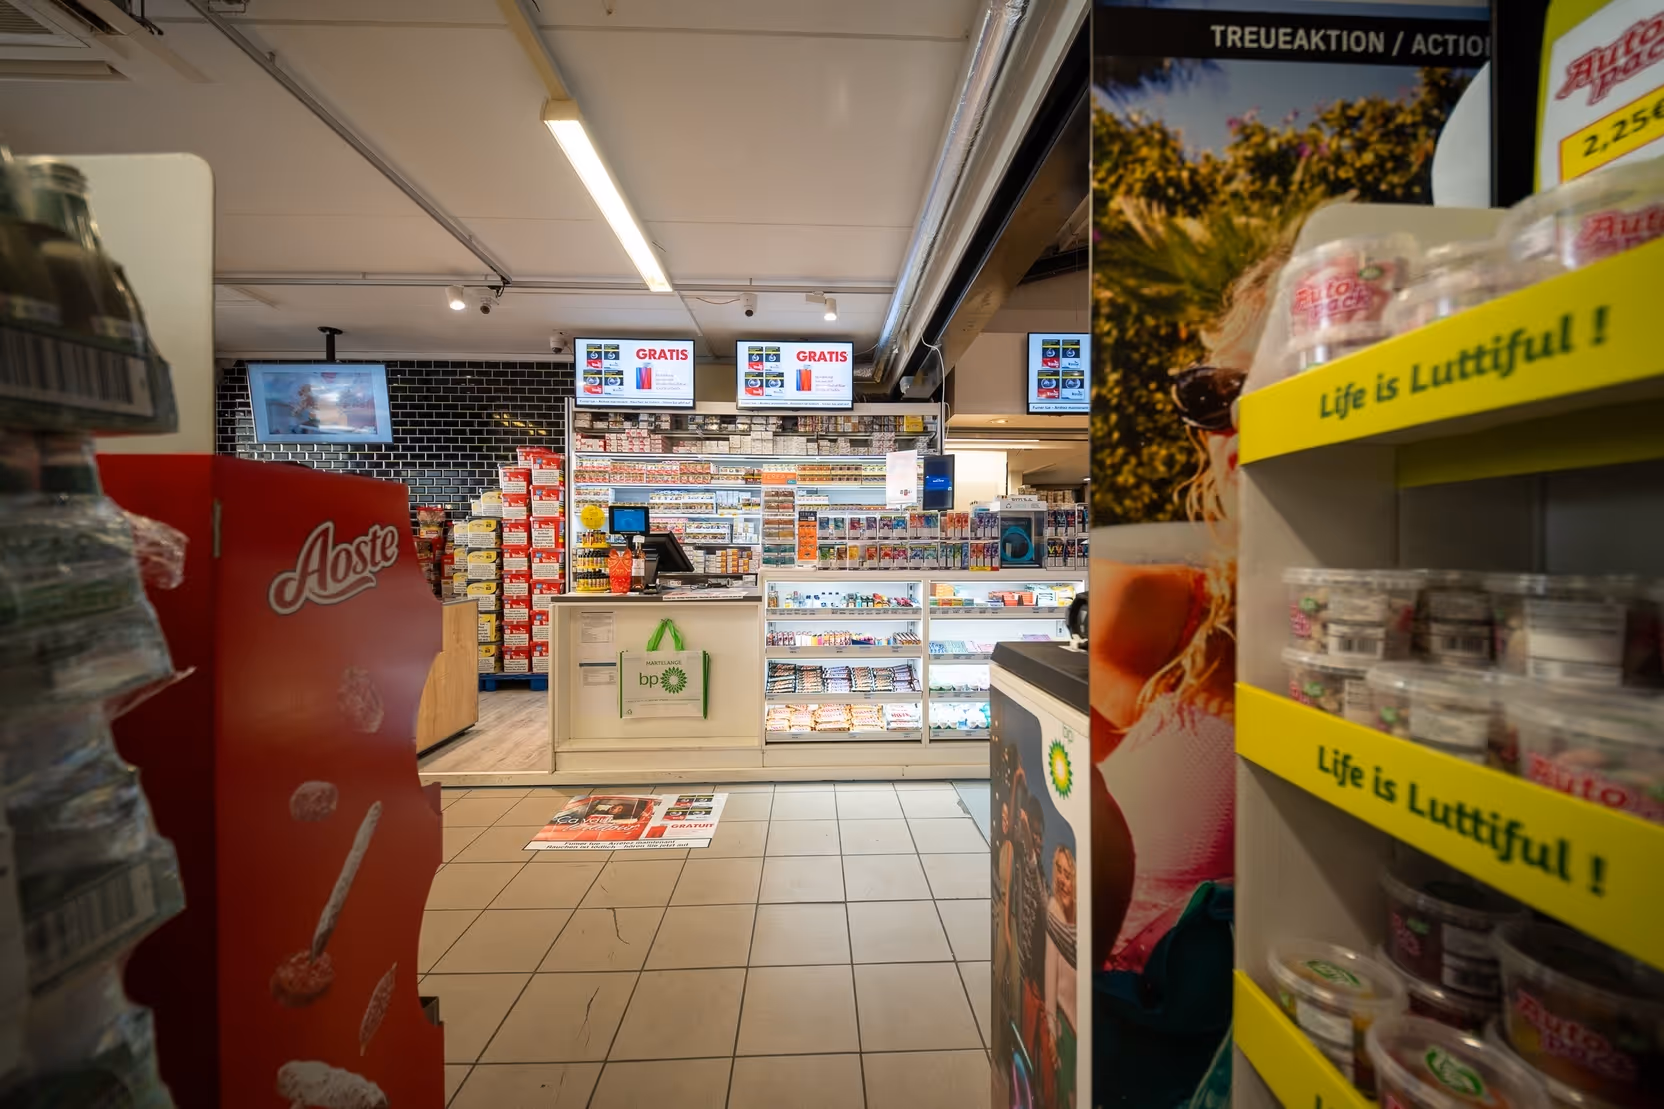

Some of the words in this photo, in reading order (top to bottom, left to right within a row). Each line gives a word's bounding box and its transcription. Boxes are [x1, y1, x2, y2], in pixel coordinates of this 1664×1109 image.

[1210, 25, 1385, 53] TREUEAKTION
[635, 348, 689, 361] GRATIS
[796, 350, 848, 362] GRATIS
[1320, 381, 1366, 420] Life
[1376, 373, 1399, 404] is
[1410, 313, 1574, 394] Luttiful
[1591, 305, 1610, 347] !
[268, 520, 399, 615] Aoste
[639, 672, 659, 688] bp
[1317, 745, 1365, 789] Life
[1373, 766, 1397, 803] is
[1407, 782, 1572, 884] Luttiful
[1587, 854, 1606, 897] !
